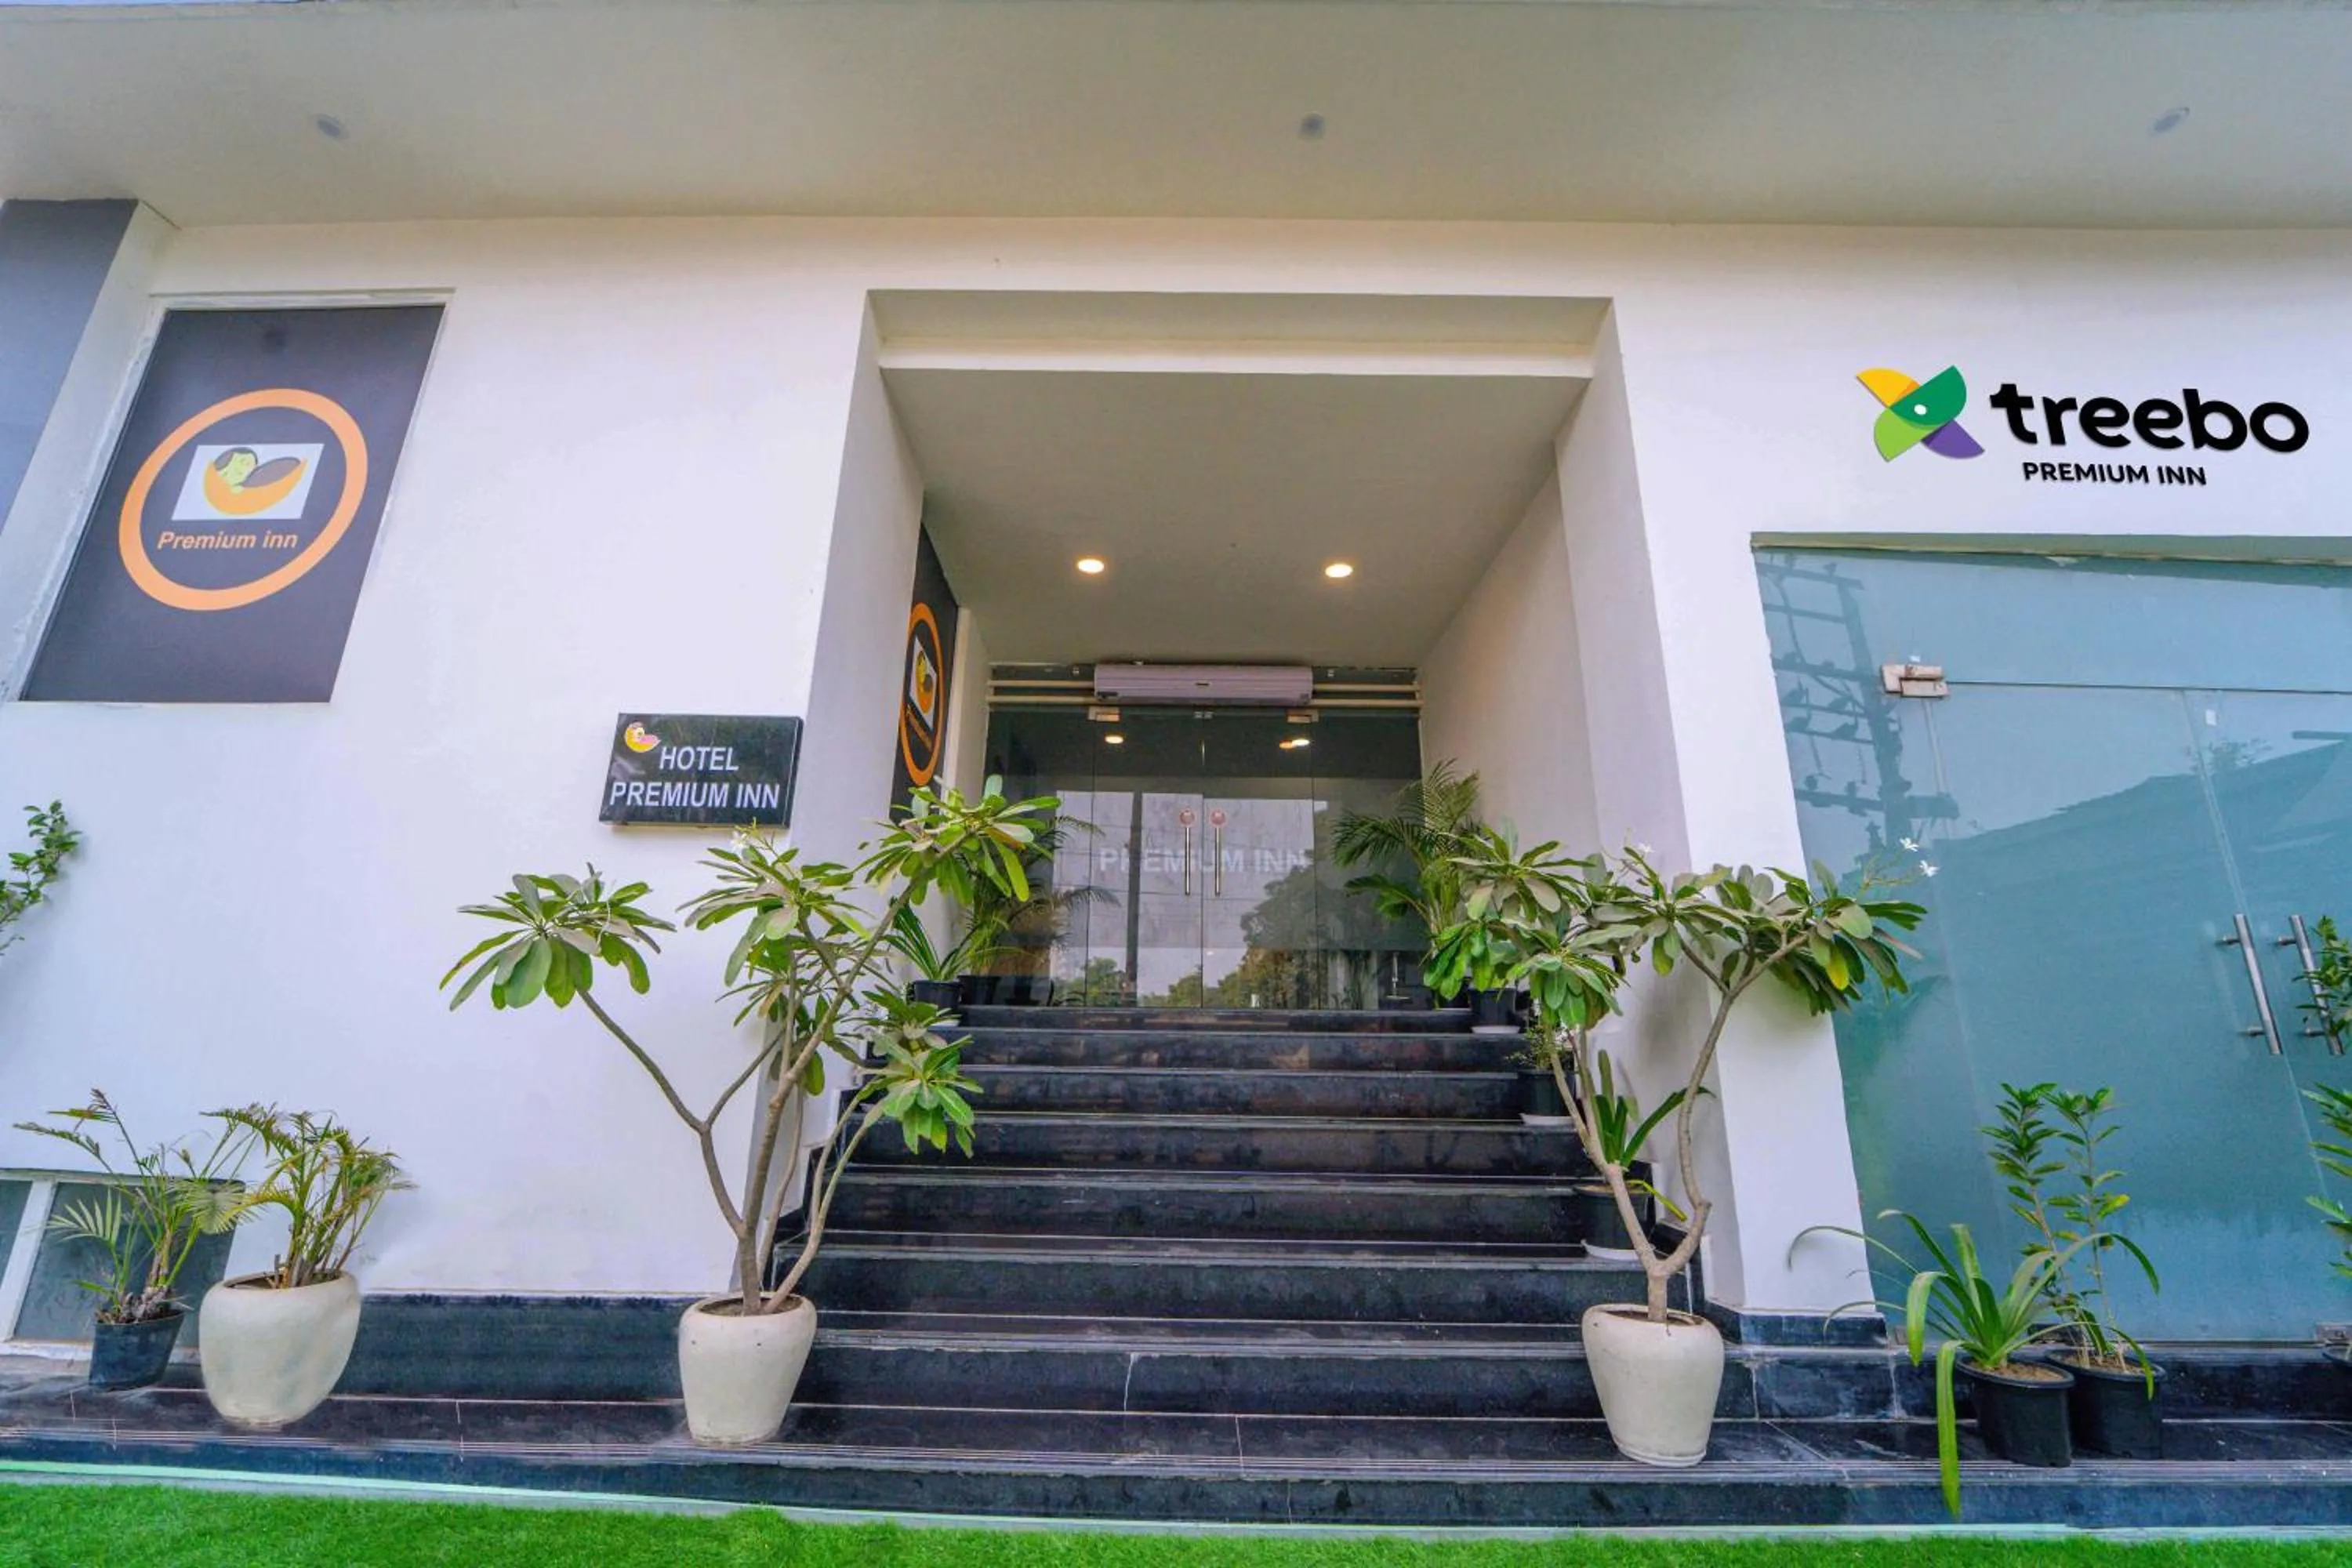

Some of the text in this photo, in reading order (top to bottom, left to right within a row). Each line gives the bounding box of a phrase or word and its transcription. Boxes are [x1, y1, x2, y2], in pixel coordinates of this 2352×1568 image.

[1990, 383, 2310, 453] treebo
[2023, 462, 2207, 486] PREMIUM INN
[157, 529, 298, 550] Premium inn
[659, 746, 739, 771] HOTEL
[609, 782, 780, 809] PREMIUM INN
